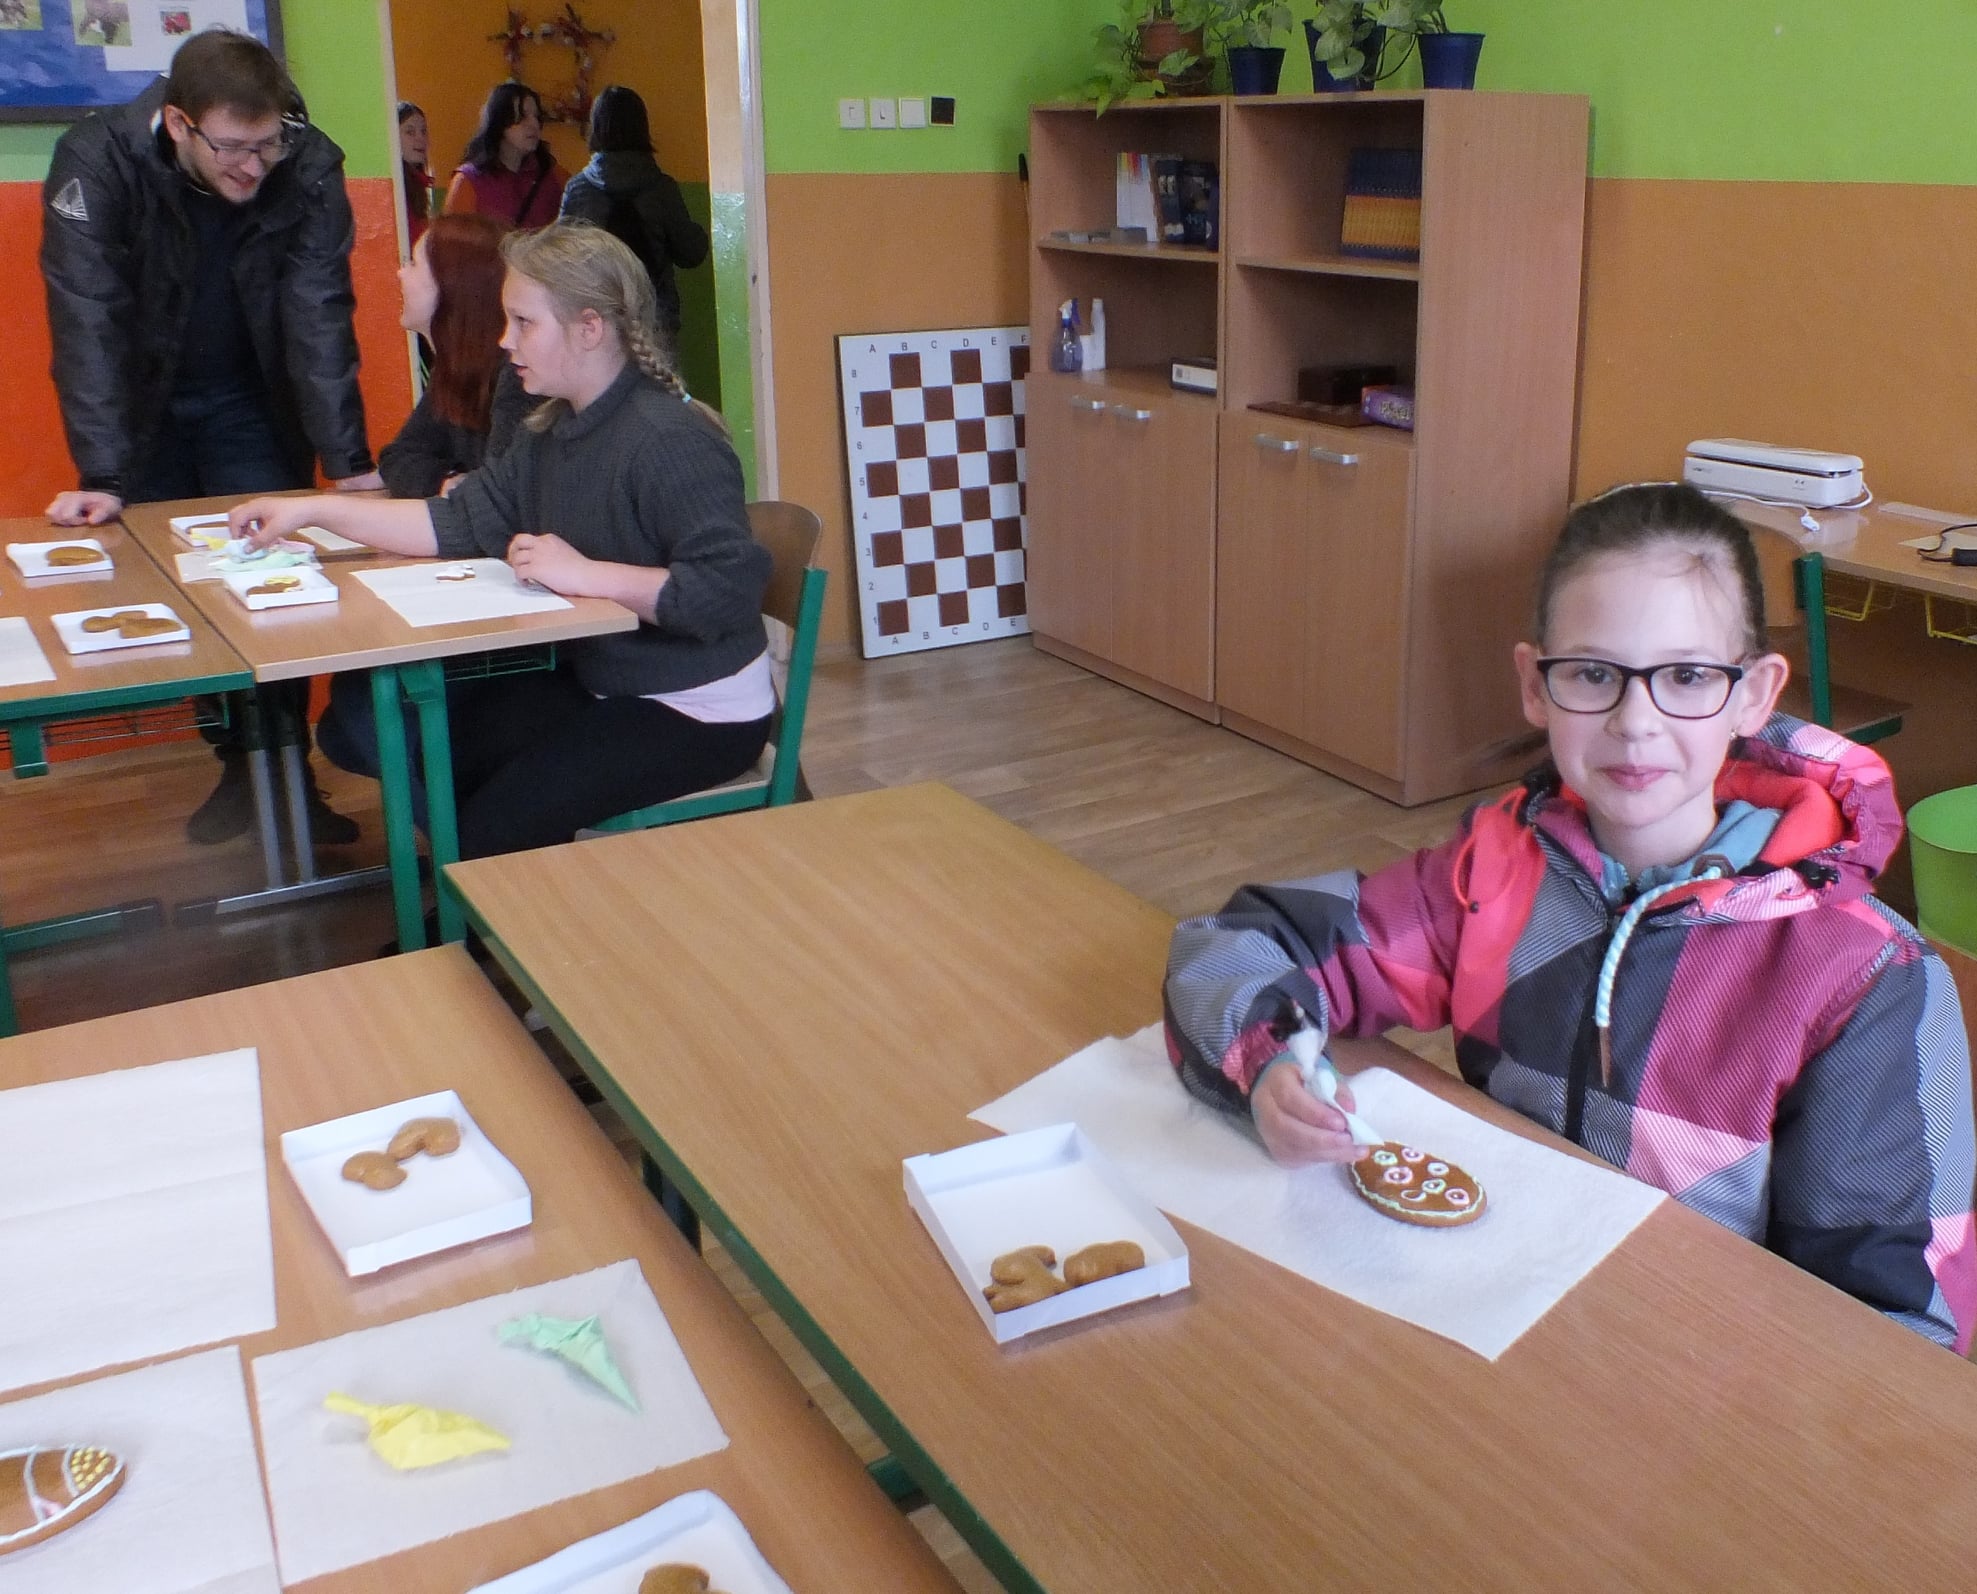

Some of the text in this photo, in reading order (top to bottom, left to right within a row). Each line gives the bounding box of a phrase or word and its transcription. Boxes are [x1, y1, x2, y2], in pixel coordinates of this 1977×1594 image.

[869, 344, 877, 353] A
[901, 342, 908, 351] B
[930, 340, 938, 349] C
[962, 338, 969, 347] D
[991, 336, 997, 345] E
[854, 406, 860, 415] 7
[856, 441, 863, 450] 6
[859, 477, 865, 486] 5
[862, 512, 868, 520] 4
[865, 548, 871, 556] 3
[868, 582, 874, 590] 2
[892, 636, 899, 644] A
[923, 631, 930, 640] B
[951, 627, 958, 635] C
[1010, 618, 1017, 626] E
